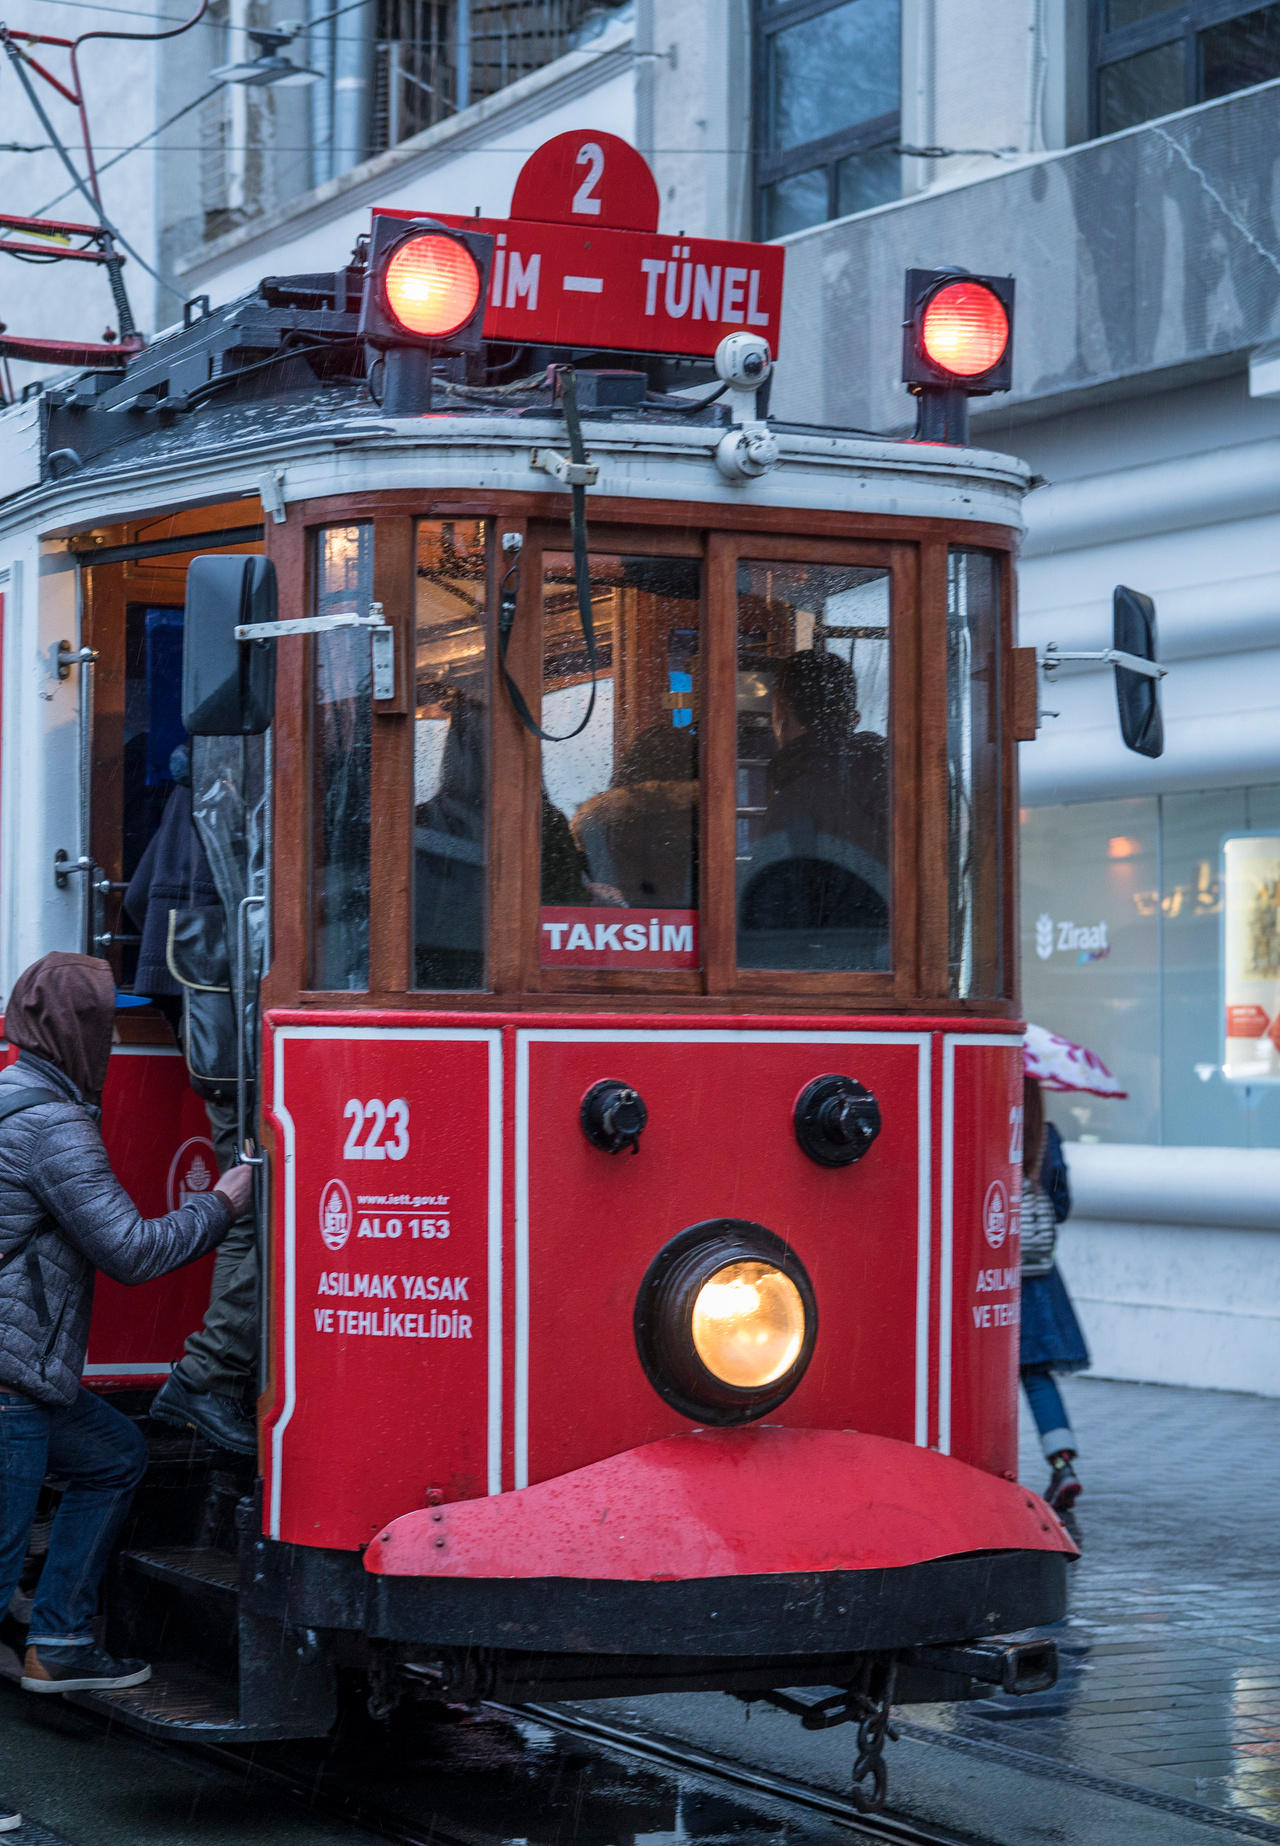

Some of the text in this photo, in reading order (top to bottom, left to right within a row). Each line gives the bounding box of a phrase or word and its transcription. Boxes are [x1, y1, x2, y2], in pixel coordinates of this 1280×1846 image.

[571, 141, 605, 215] 2
[640, 245, 770, 327] TÜNEL
[542, 917, 694, 952] TAKSİM
[1056, 920, 1108, 951] Ziraat
[342, 1098, 411, 1161] 223
[356, 1193, 451, 1208] www.iett.gov.tr
[356, 1218, 451, 1240] ALO 153
[317, 1271, 469, 1301] ASILMAK YASAK
[314, 1306, 473, 1339] VE TEHLİKELİDİR
[972, 1305, 991, 1329] VE
